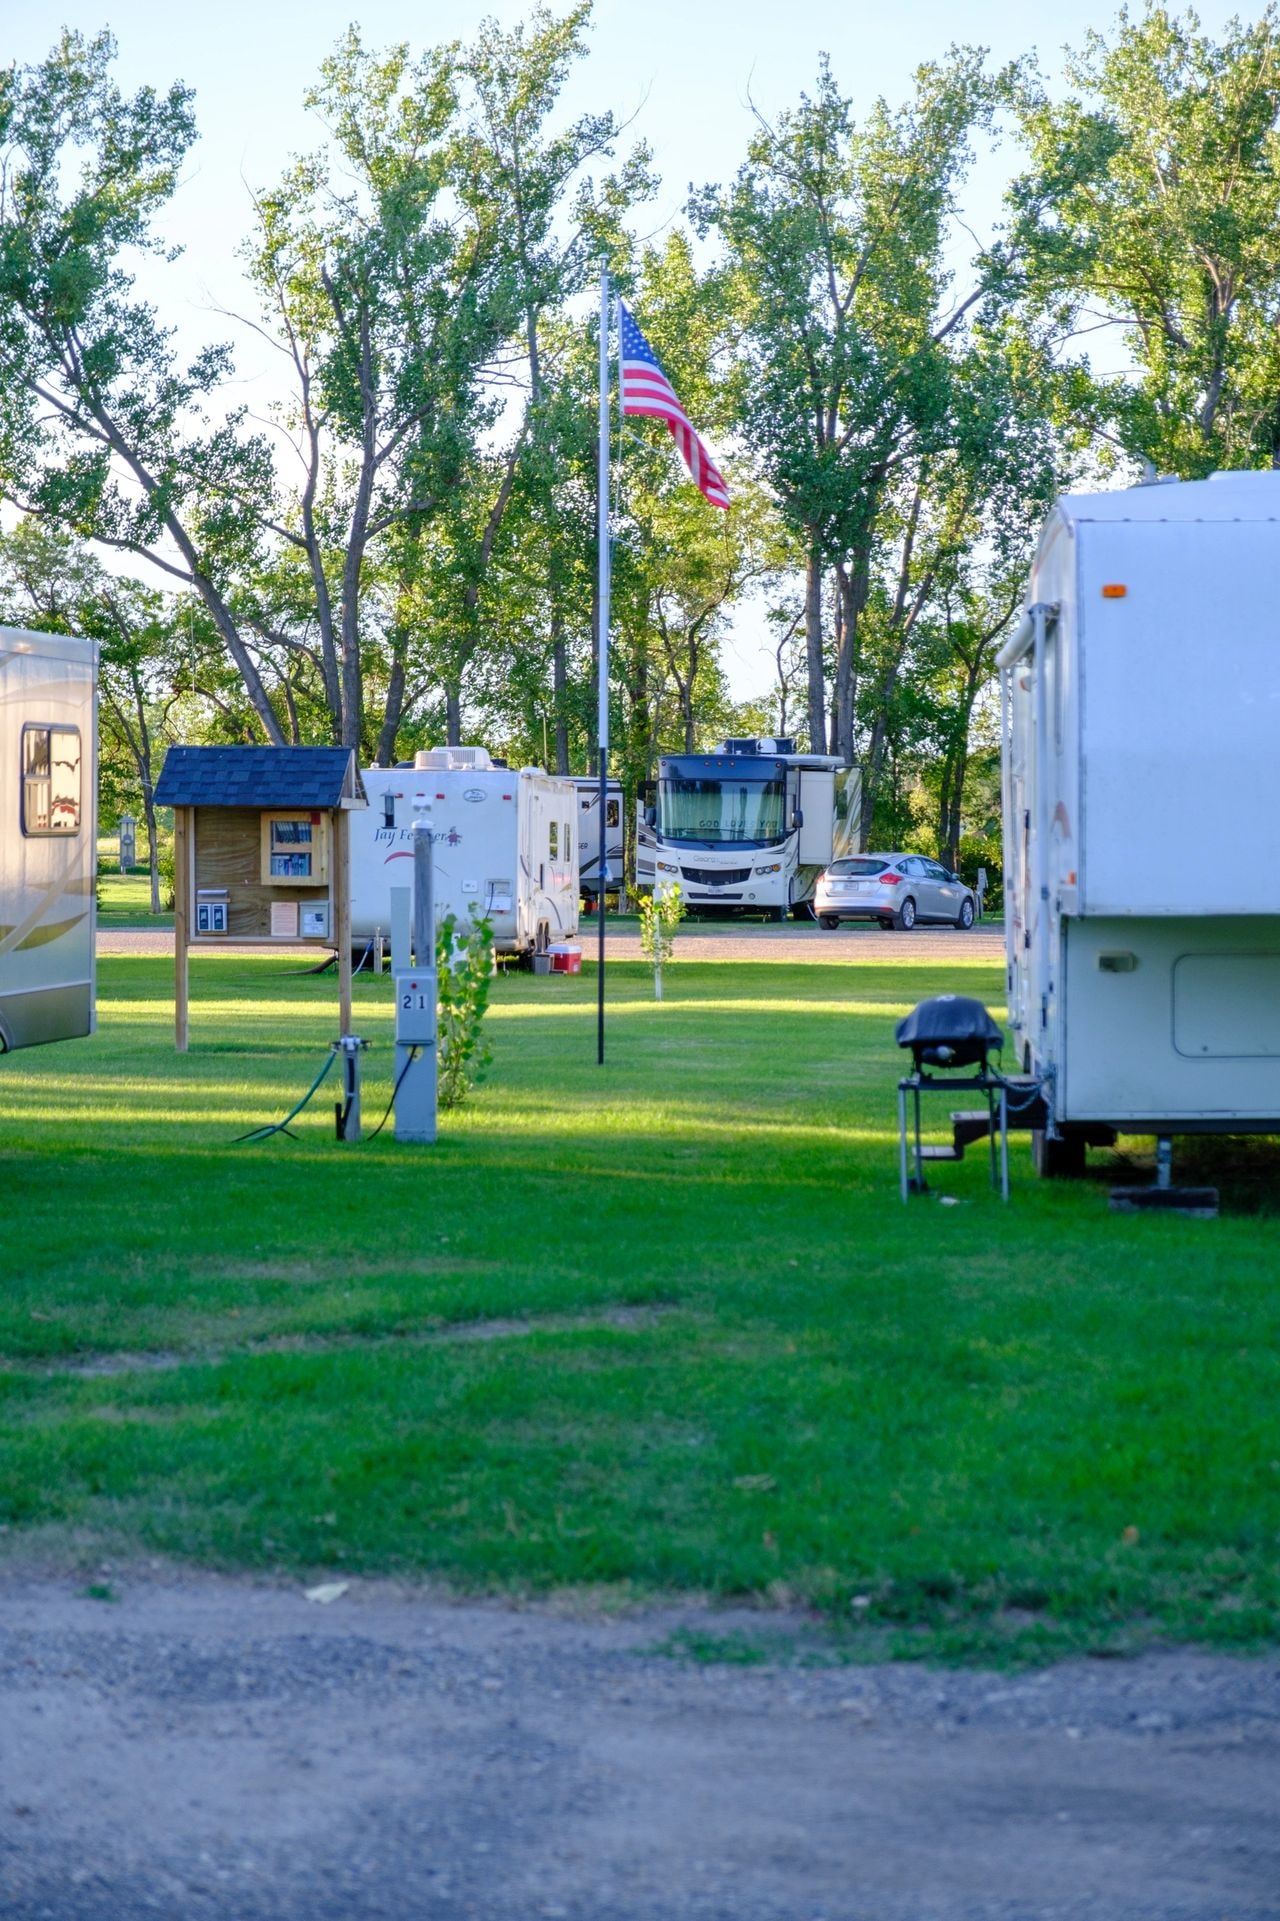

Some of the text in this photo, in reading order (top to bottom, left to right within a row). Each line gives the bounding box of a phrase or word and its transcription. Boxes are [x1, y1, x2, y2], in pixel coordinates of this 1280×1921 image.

[699, 819, 719, 827] GOD
[760, 819, 778, 828] YOU
[374, 828, 447, 848] Jay Feer
[403, 995, 425, 1009] 21
